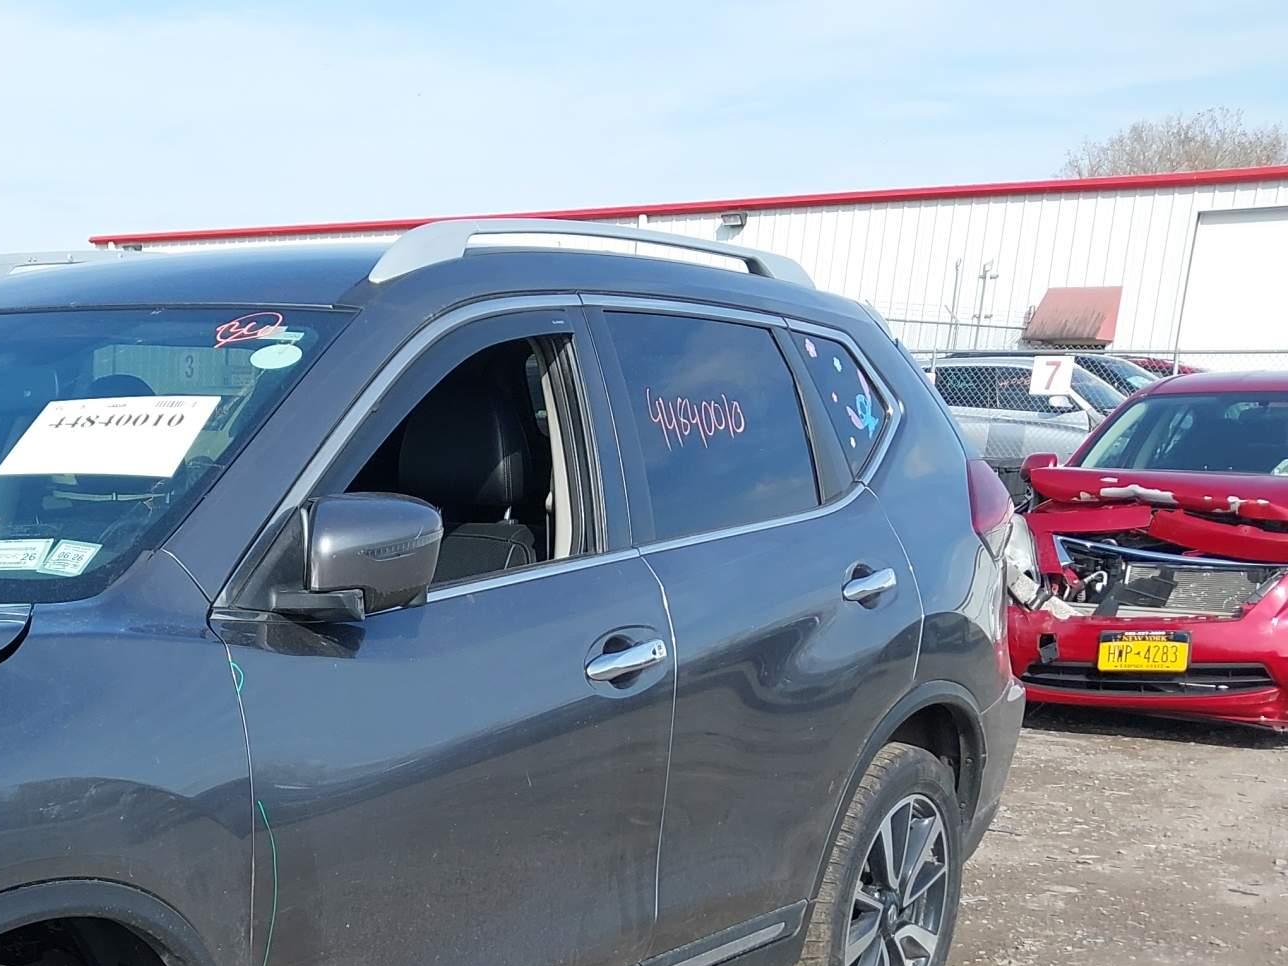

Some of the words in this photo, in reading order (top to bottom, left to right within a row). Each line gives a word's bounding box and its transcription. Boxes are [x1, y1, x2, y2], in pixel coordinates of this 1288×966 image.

[1044, 360, 1063, 391] 7
[48, 413, 185, 429] 44840010
[646, 387, 746, 452] 44840010
[20, 552, 37, 561] 26
